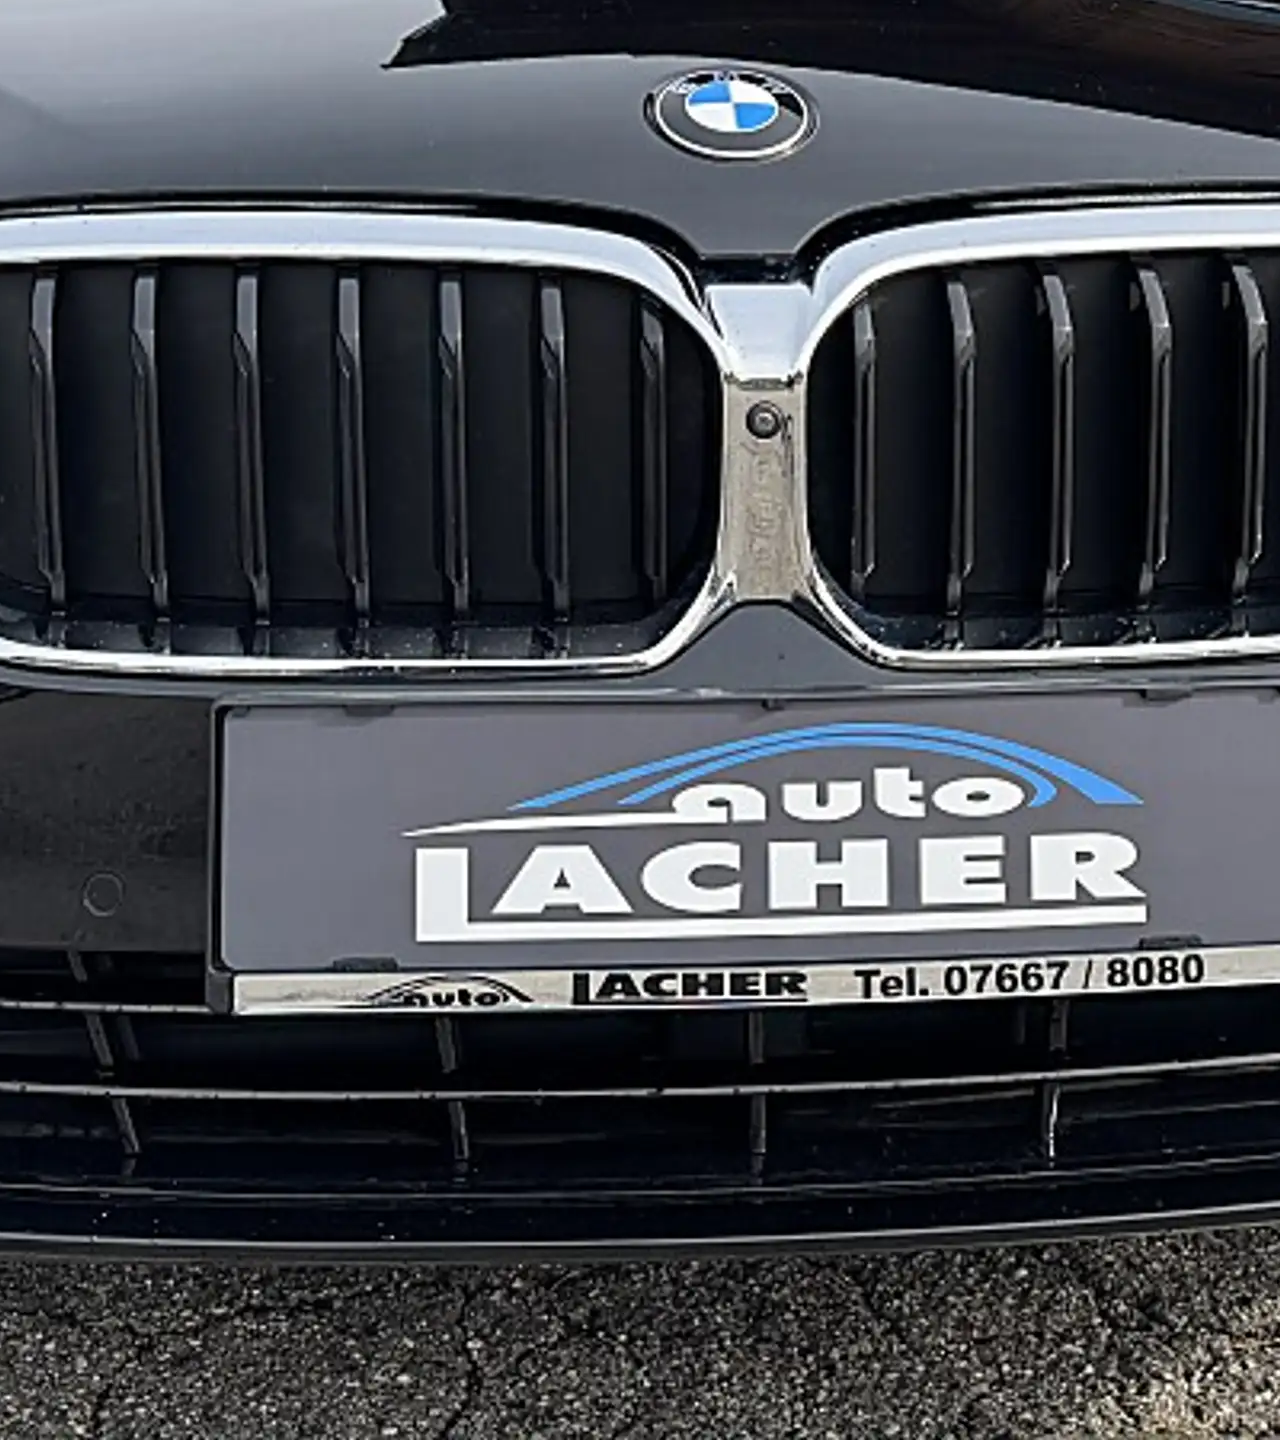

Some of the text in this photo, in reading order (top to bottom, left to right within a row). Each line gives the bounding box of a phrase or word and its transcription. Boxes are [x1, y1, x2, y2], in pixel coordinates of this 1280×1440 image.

[670, 767, 1027, 824] auto
[416, 832, 1148, 942] LACHER
[402, 953, 1205, 1007] auto LACHER Tel. 07667 / 8080
